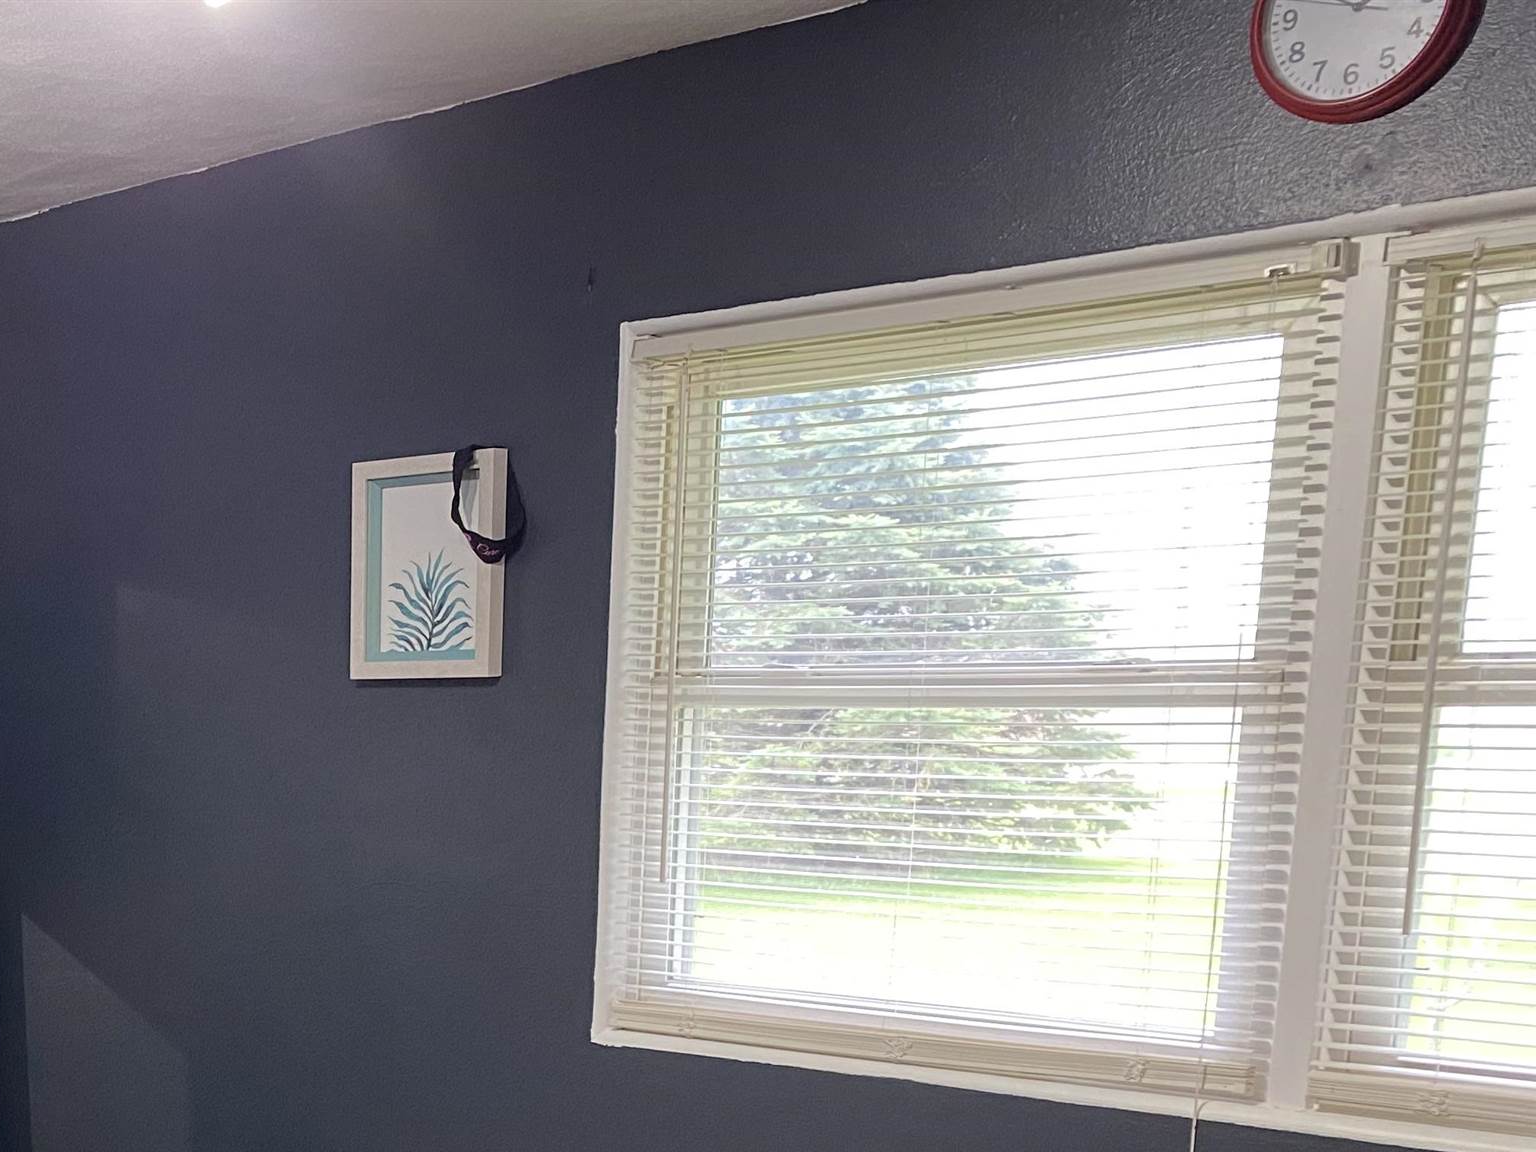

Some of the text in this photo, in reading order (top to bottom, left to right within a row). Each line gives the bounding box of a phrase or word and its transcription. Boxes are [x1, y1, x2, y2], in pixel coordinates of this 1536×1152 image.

[1282, 9, 1298, 31] 9
[1407, 16, 1424, 38] 4
[1289, 41, 1305, 63] 8
[1379, 46, 1396, 69] 5
[1313, 60, 1328, 84] 7
[1343, 63, 1360, 85] 6
